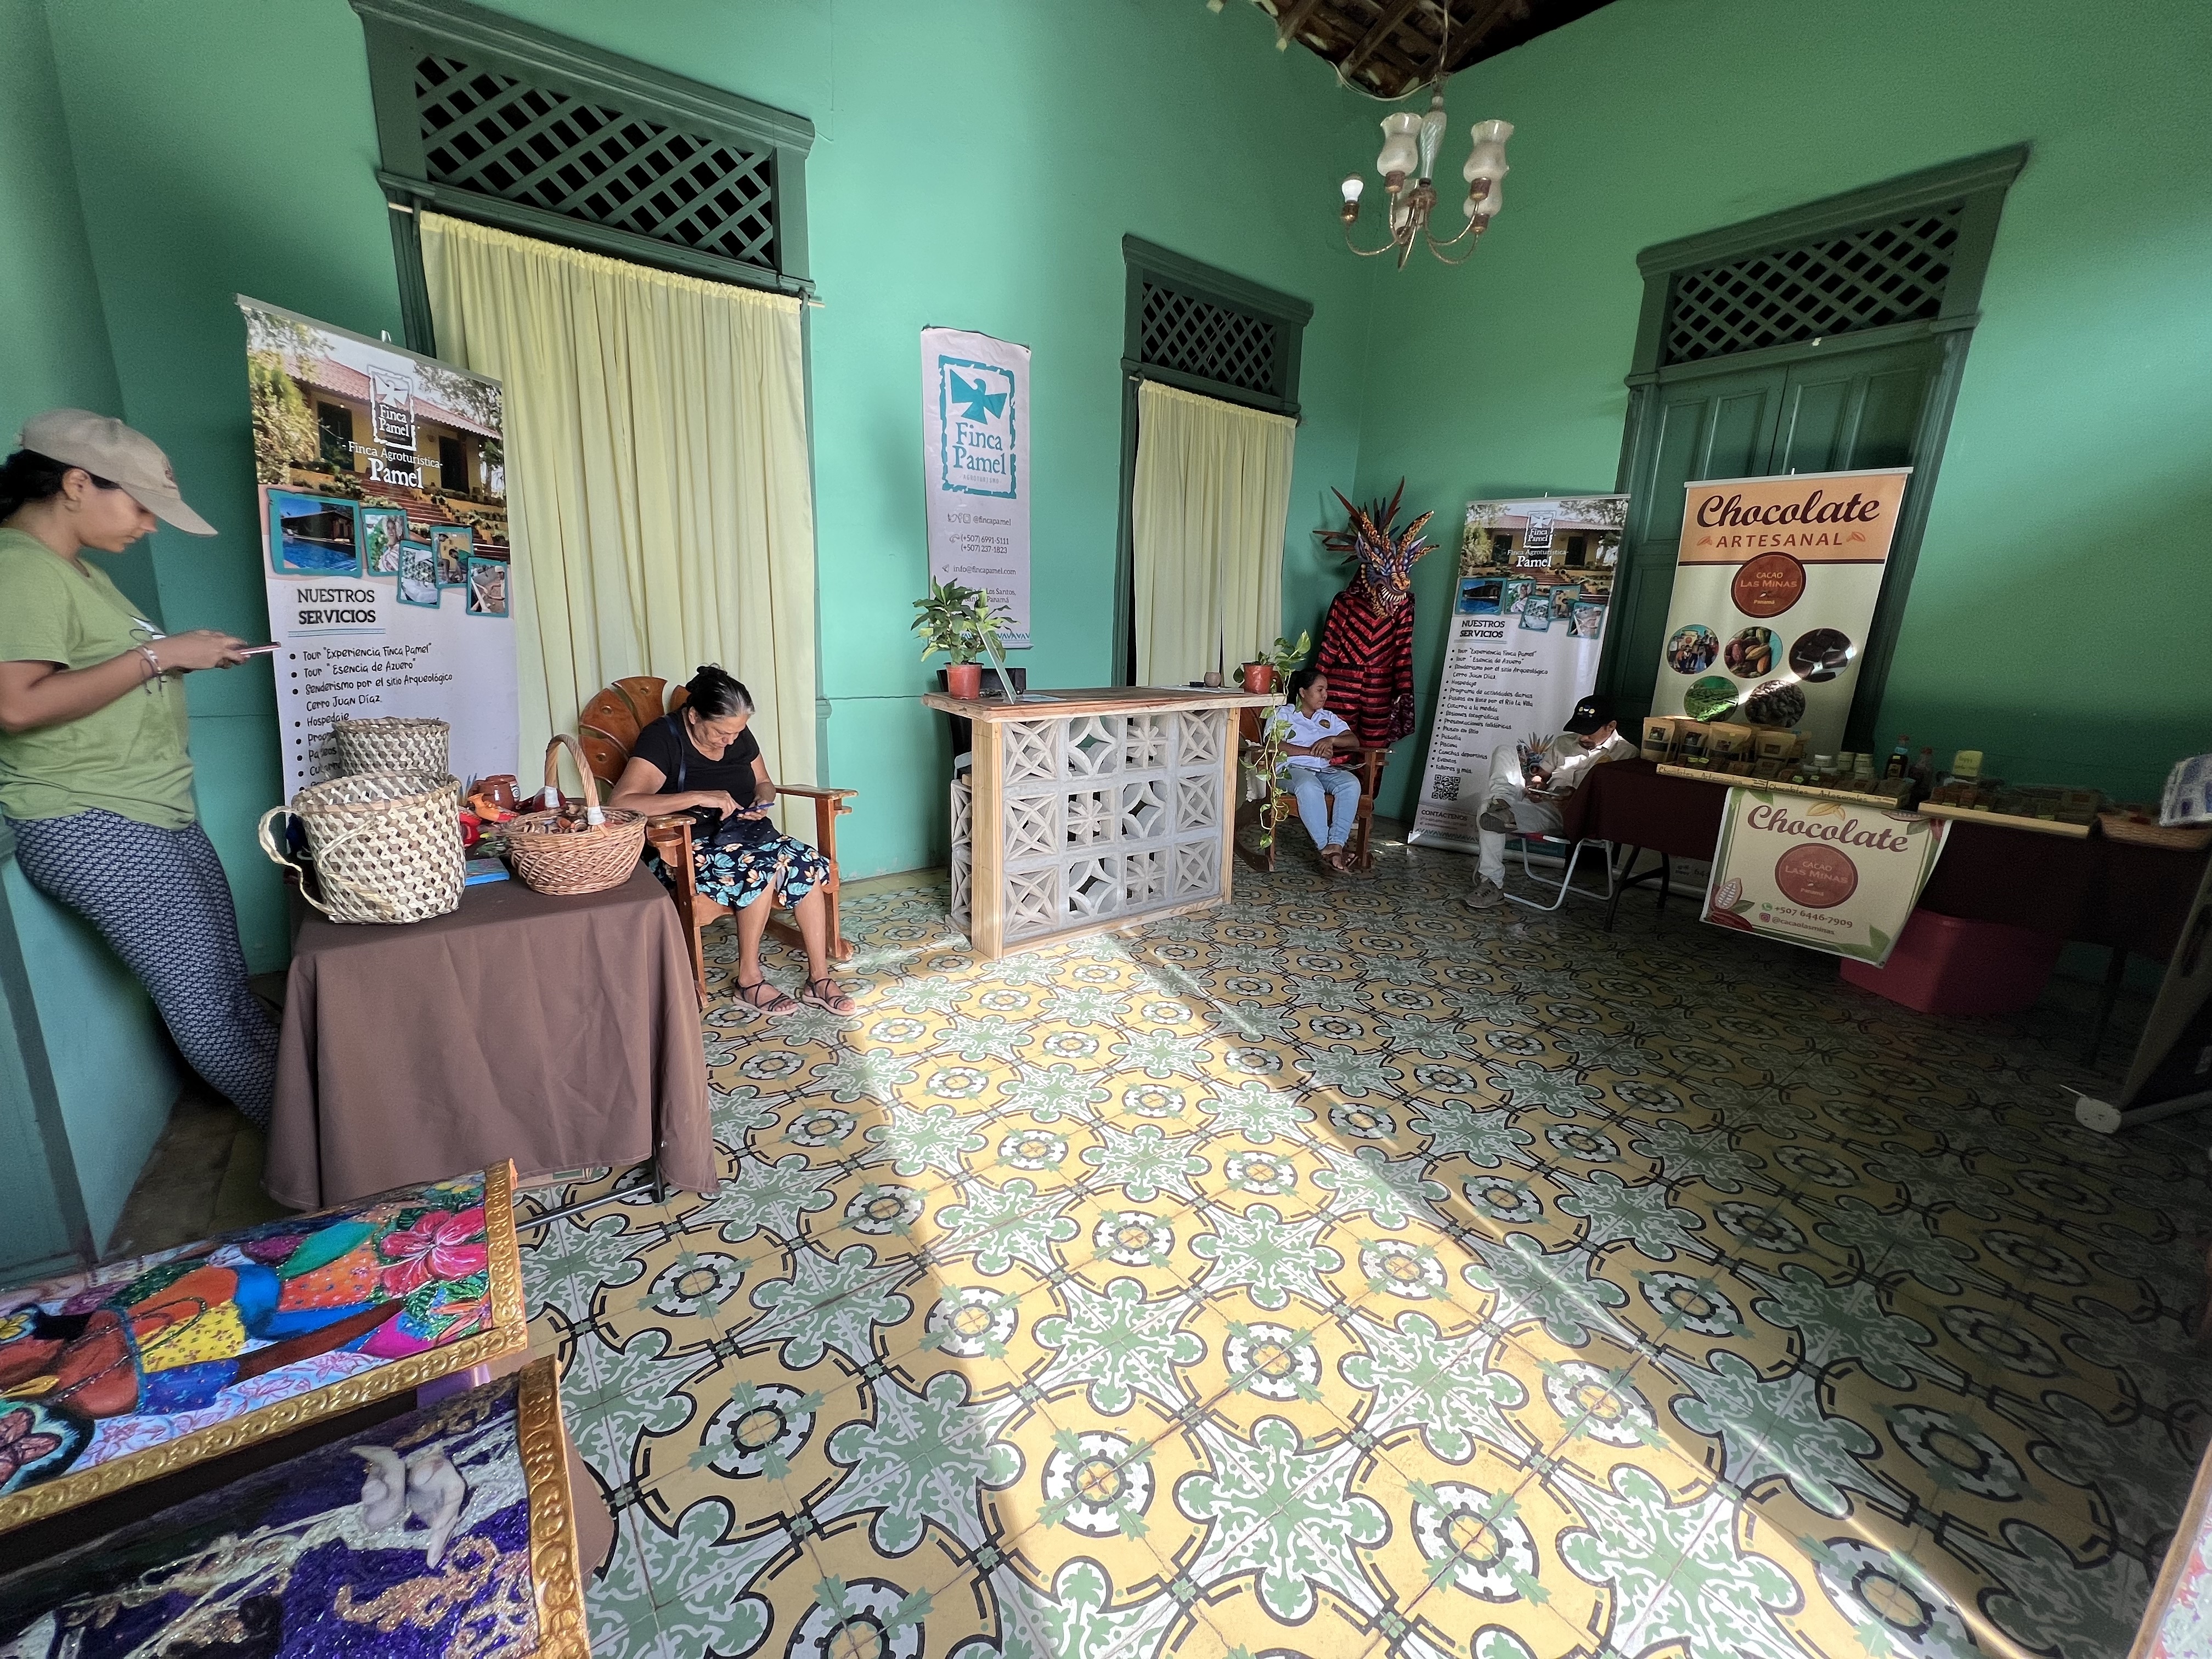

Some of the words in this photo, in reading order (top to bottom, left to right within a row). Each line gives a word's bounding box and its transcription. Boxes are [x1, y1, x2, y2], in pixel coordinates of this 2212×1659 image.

[379, 404, 407, 423] Finca
[378, 417, 410, 437] Pamel
[956, 422, 1003, 451] Finca
[348, 441, 378, 456] Finca
[952, 444, 1007, 475] Pamel
[368, 457, 424, 489] Pamel
[963, 474, 1000, 484] AGROTURISMO
[1697, 489, 1880, 528] Chocolate
[973, 516, 1012, 526] @fincapamel
[961, 534, 980, 543] (+507)
[981, 536, 1009, 545] 6991-5111
[1716, 532, 1843, 548] ARTESANAL
[961, 543, 980, 552] (+507)
[981, 545, 1008, 554] 237-1823
[1516, 555, 1552, 567] Pamel
[953, 565, 1017, 575] info@fincapamel.com
[297, 589, 375, 603] NUESTROS
[996, 588, 1017, 596] Santos,
[298, 610, 376, 624] SERVICIOS
[1462, 620, 1505, 628] NUESTROS
[303, 651, 321, 661] Tour
[323, 646, 380, 659] "Experiencia
[382, 646, 403, 657] Finca
[405, 642, 432, 656] Pamel"
[303, 668, 323, 678] Tour
[371, 661, 383, 672] de
[385, 658, 416, 672] Azuero"
[306, 681, 354, 695] Senderismo
[357, 680, 372, 692] por
[375, 677, 384, 687] el
[386, 675, 402, 687] sitio
[404, 673, 453, 686] Arqueológico
[307, 699, 330, 712] Cerro
[308, 747, 337, 762] Paeos
[1818, 790, 1867, 803] Artesanales
[1747, 805, 1909, 853] Chocolate
[1802, 861, 1832, 871] CACAO
[1785, 865, 1806, 876] LAS
[1809, 870, 1848, 884] MINAS
[1774, 906, 1797, 916] +507
[1800, 910, 1853, 928] 6446-7909
[1771, 916, 1835, 935] @cacaolasminas
